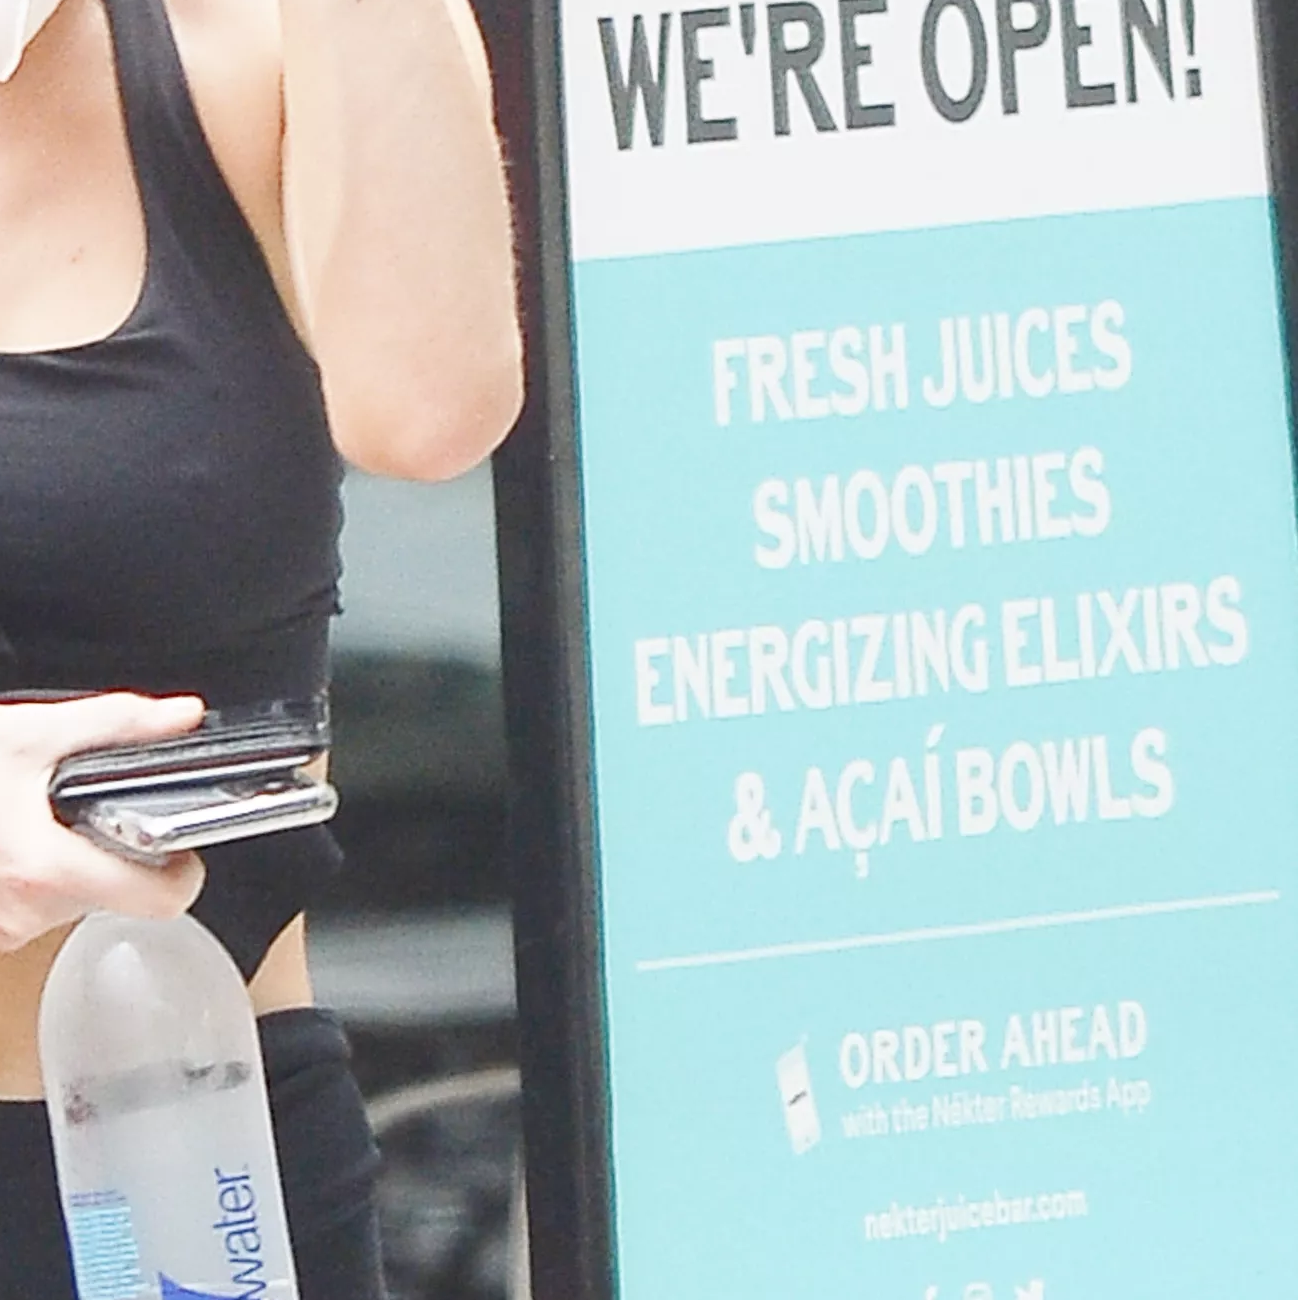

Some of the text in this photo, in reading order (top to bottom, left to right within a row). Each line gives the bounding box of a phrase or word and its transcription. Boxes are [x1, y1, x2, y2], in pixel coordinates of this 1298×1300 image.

[712, 299, 1133, 427] FRESH JUICES
[752, 445, 1112, 570] SMOOTHIES
[633, 574, 1249, 727] ENERGIZING ELIXIRS
[727, 723, 1177, 879] & AÇAÍ BOWLS
[839, 1000, 1148, 1090] ORDER AHEAD
[840, 1101, 889, 1138] with
[892, 1098, 929, 1134] the
[1009, 1077, 1101, 1121] Rewards
[1105, 1075, 1152, 1115] App
[863, 1189, 1089, 1243] nekterjuicebar.com
